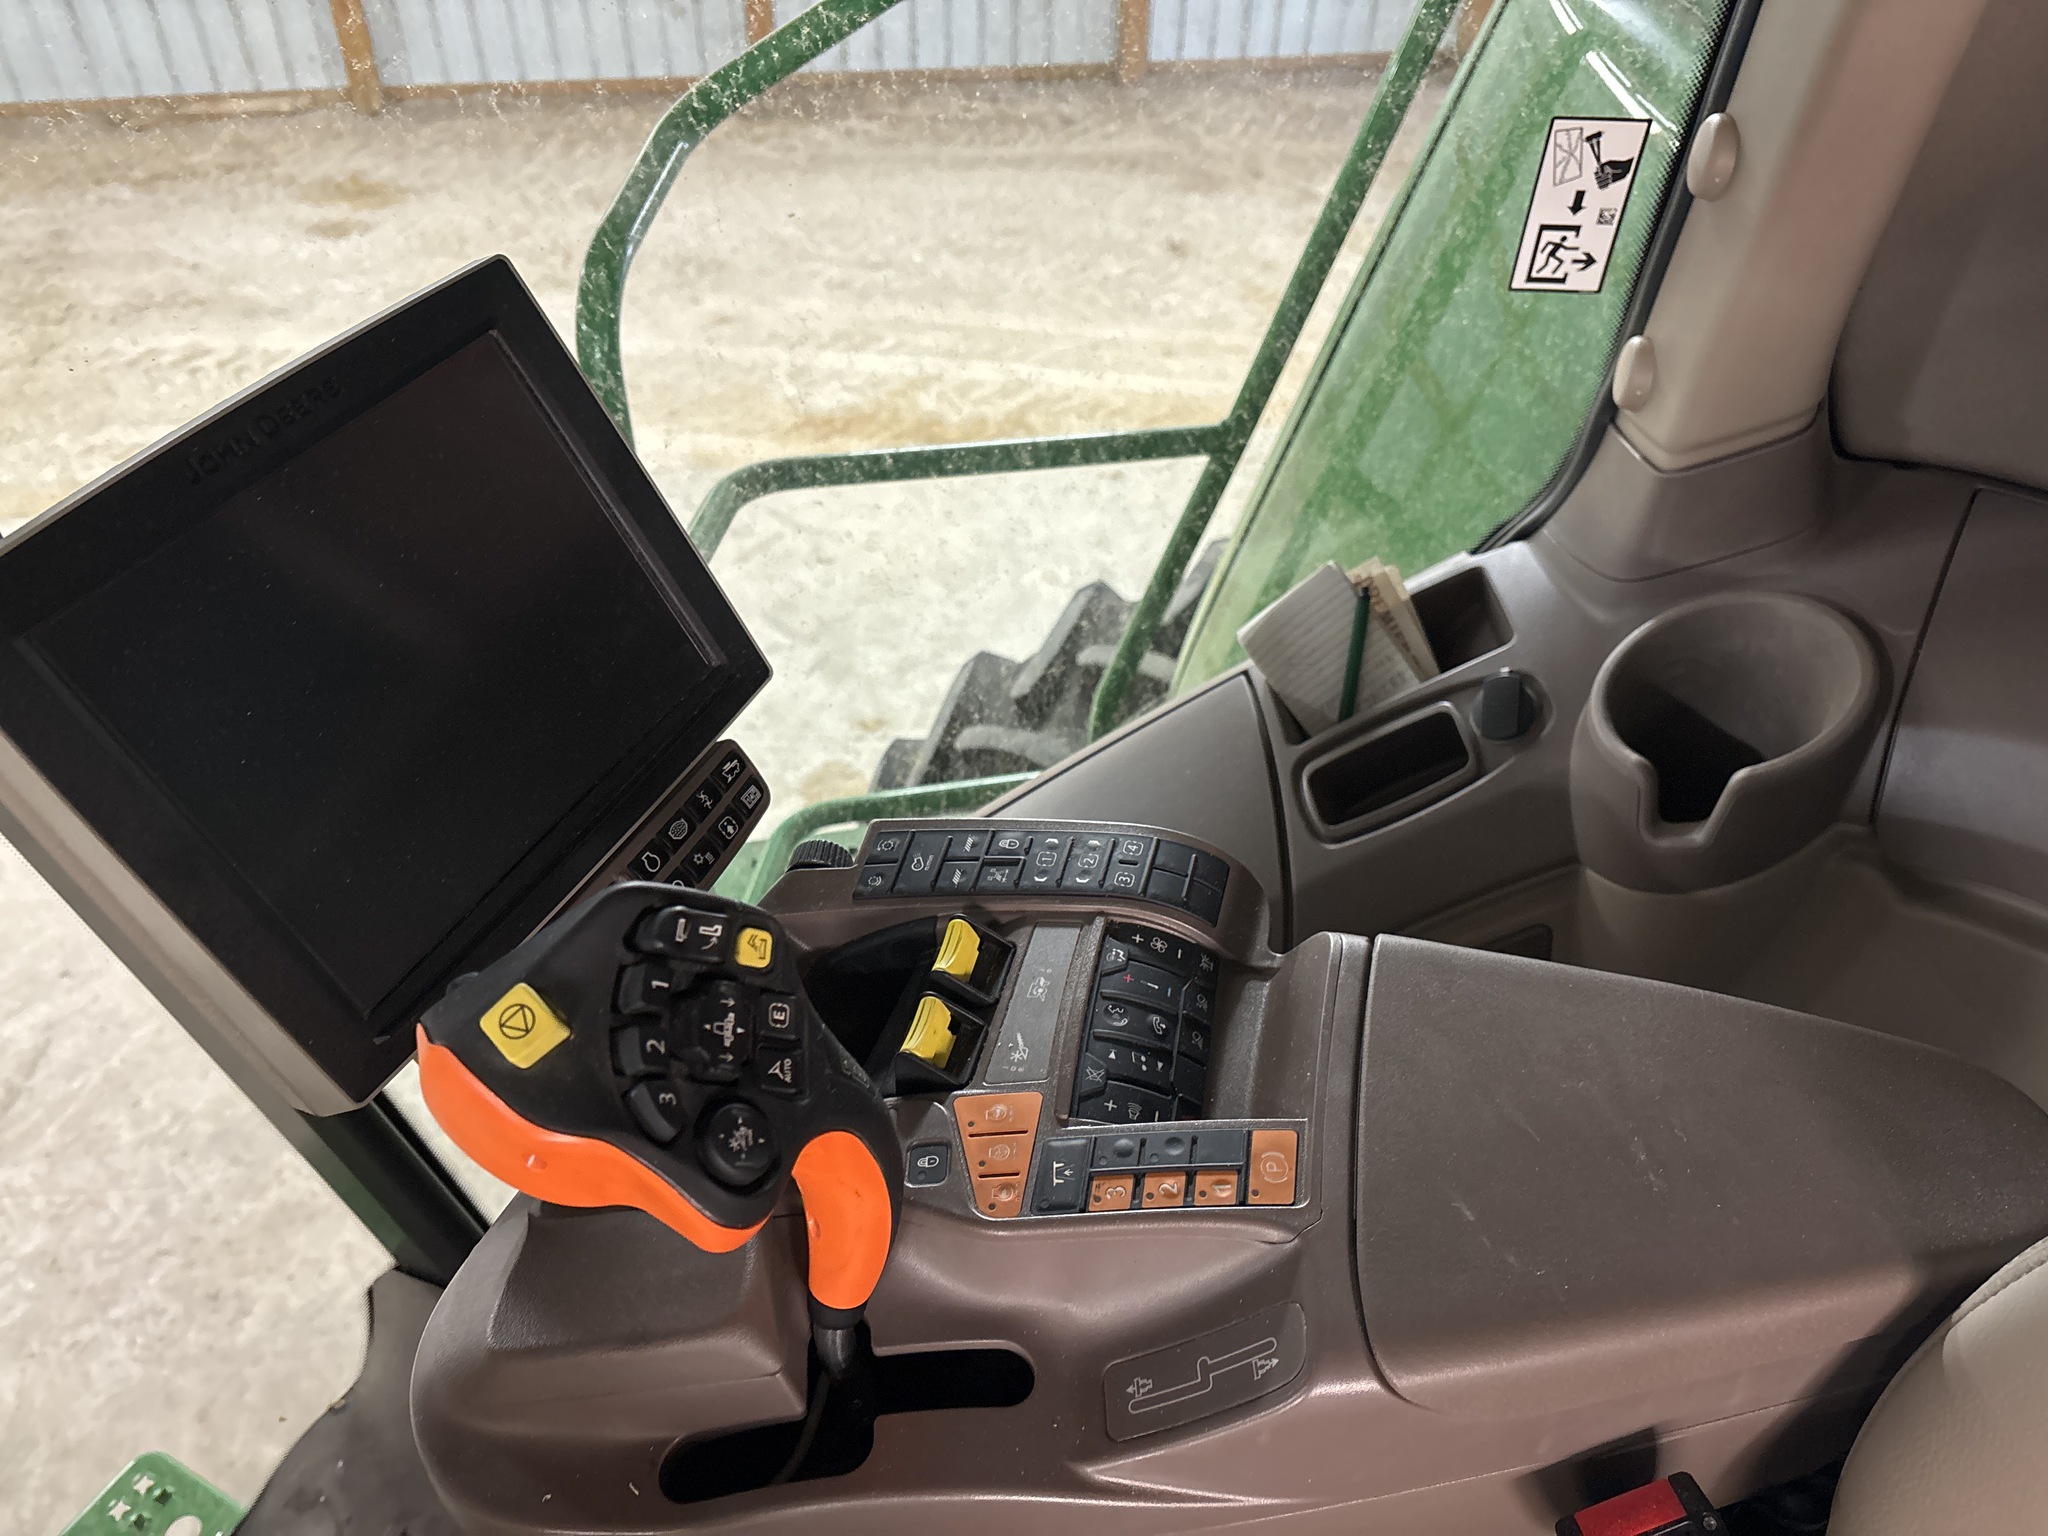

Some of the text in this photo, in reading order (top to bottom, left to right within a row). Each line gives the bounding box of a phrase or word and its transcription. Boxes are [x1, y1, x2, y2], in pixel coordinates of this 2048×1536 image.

[650, 980, 670, 990] 1
[773, 1010, 785, 1021] E
[646, 1039, 666, 1055] 2
[784, 1058, 794, 1083] AUTO
[658, 1092, 677, 1106] 3
[1266, 1161, 1284, 1173] P
[1105, 1186, 1127, 1200] 3
[1158, 1181, 1179, 1195] 2
[1211, 1183, 1232, 1193] 1
